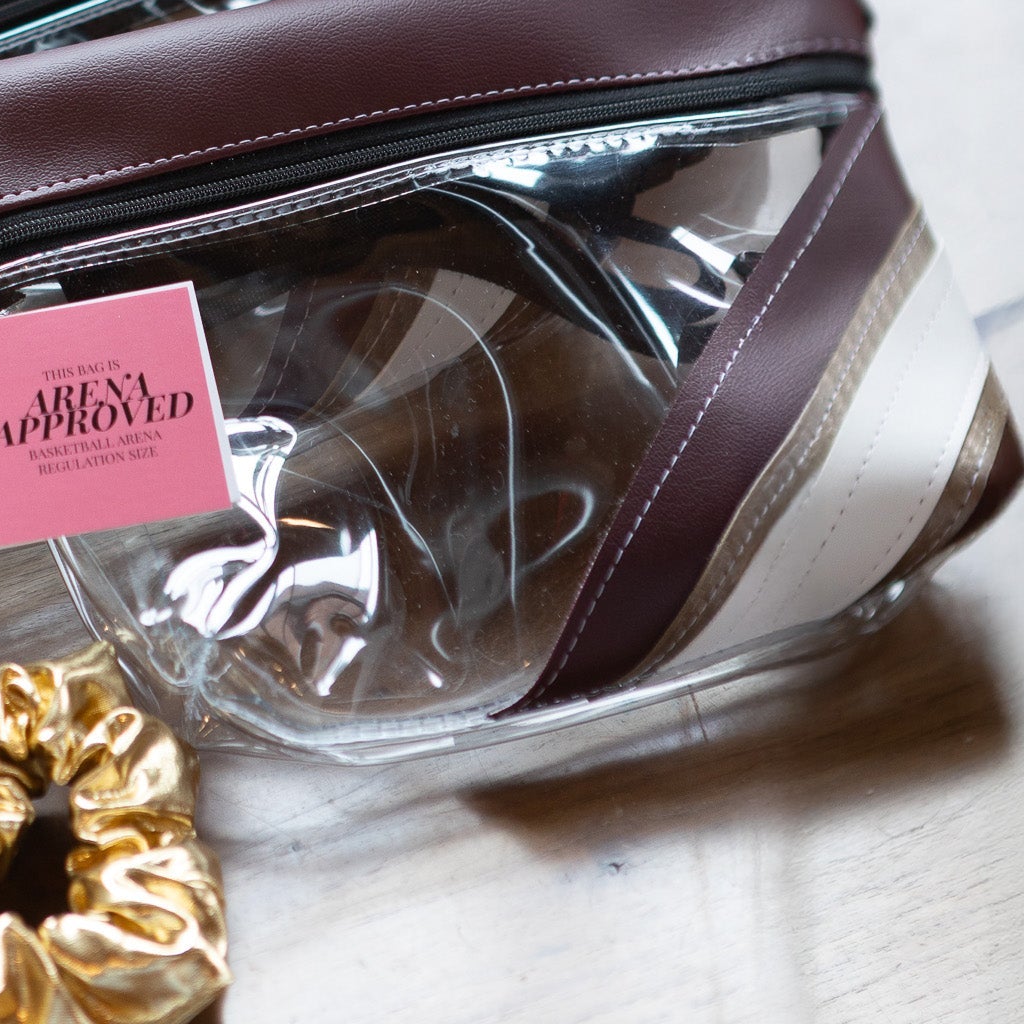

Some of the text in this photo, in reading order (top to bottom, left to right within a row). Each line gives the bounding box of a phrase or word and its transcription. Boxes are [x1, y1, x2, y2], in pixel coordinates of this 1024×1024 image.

[42, 359, 121, 382] THIS BAG IS
[25, 372, 151, 418] ARENA
[28, 429, 163, 462] BASKETBALL ARENA
[38, 446, 159, 477] REGULATION SIZE
